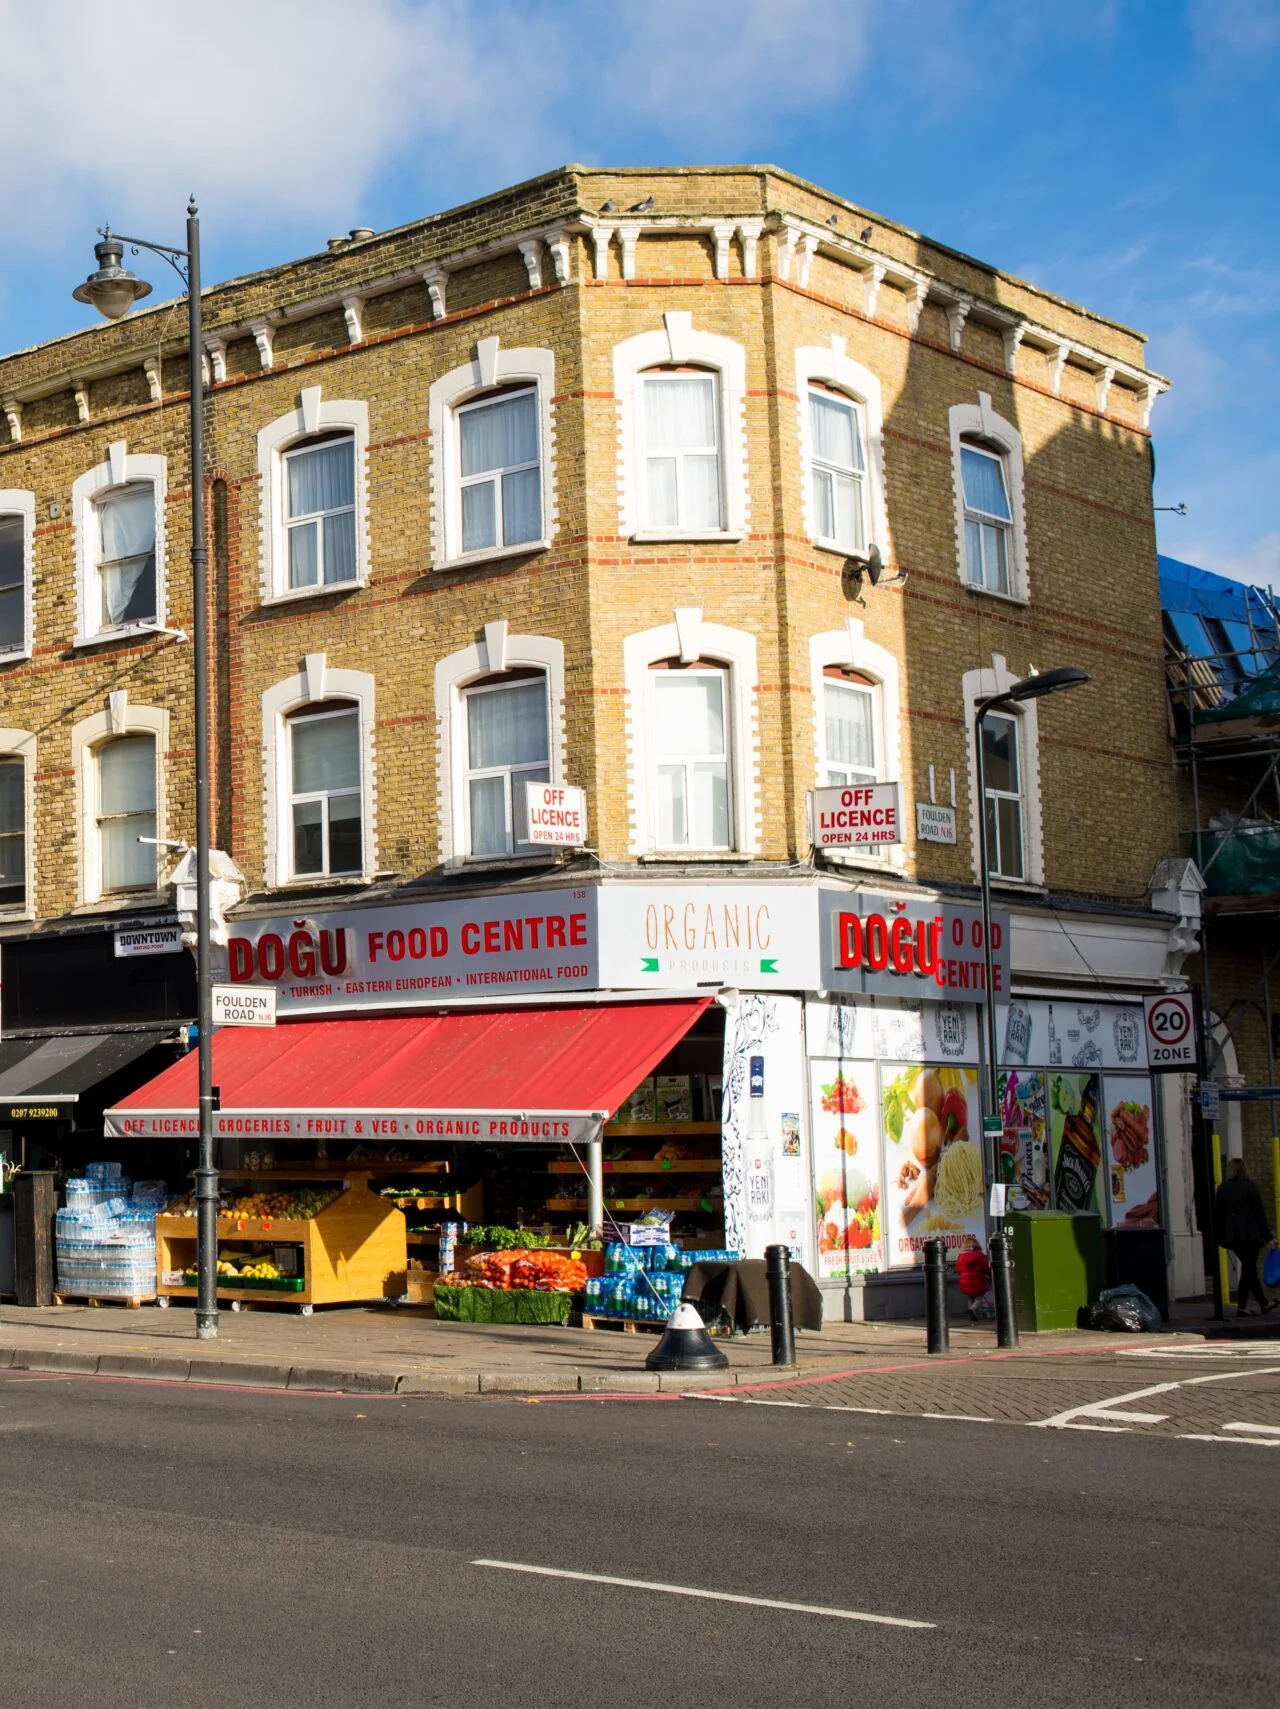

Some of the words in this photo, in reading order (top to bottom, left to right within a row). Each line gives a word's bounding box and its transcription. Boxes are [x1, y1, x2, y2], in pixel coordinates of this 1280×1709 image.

[544, 788, 564, 806] OFF
[841, 789, 874, 807] OFF
[531, 808, 580, 828] LICENCE
[820, 808, 896, 829] LICENCE
[922, 809, 951, 824] FOULDEN
[533, 830, 553, 840] OPEN
[554, 832, 564, 840] 24
[565, 832, 580, 842] HRS
[822, 832, 852, 843] OPEN
[855, 832, 868, 842] 24
[872, 830, 896, 841] HRS
[572, 890, 586, 899] 158
[646, 902, 771, 950] ORGANIC
[934, 915, 1002, 950] FOOD
[120, 931, 177, 946] DOWNTOWN
[838, 901, 939, 976] DOĞU
[227, 920, 347, 982] DOĞU
[367, 926, 449, 962] FOOD
[460, 912, 588, 956] CENTRE
[669, 959, 751, 972] PRODUCTS
[289, 984, 332, 998] TURKISH
[345, 980, 392, 994] EASTERN
[395, 976, 452, 991] EUROPEAN
[466, 967, 553, 986] INTERNATIONAL
[557, 965, 588, 979] FOOD
[935, 958, 1002, 992] CENTE
[216, 996, 267, 1008] FOULDEN
[224, 1009, 255, 1020] ROAD
[1154, 1011, 1184, 1031] 20
[943, 1030, 960, 1044] RAKI
[1152, 1047, 1192, 1060] ZONE
[11, 1108, 28, 1118] 0207
[28, 1108, 58, 1117] 9239200
[124, 1119, 145, 1132] OFF
[218, 1118, 291, 1133] GROCERIES
[307, 1119, 347, 1133] FRUIT
[354, 1120, 363, 1134] &
[372, 1120, 398, 1134] VEG
[416, 1120, 480, 1135] ORGANIC
[490, 1120, 570, 1137] PRODUCTS
[750, 1190, 770, 1205] RAKI
[824, 1255, 843, 1266] FRESH
